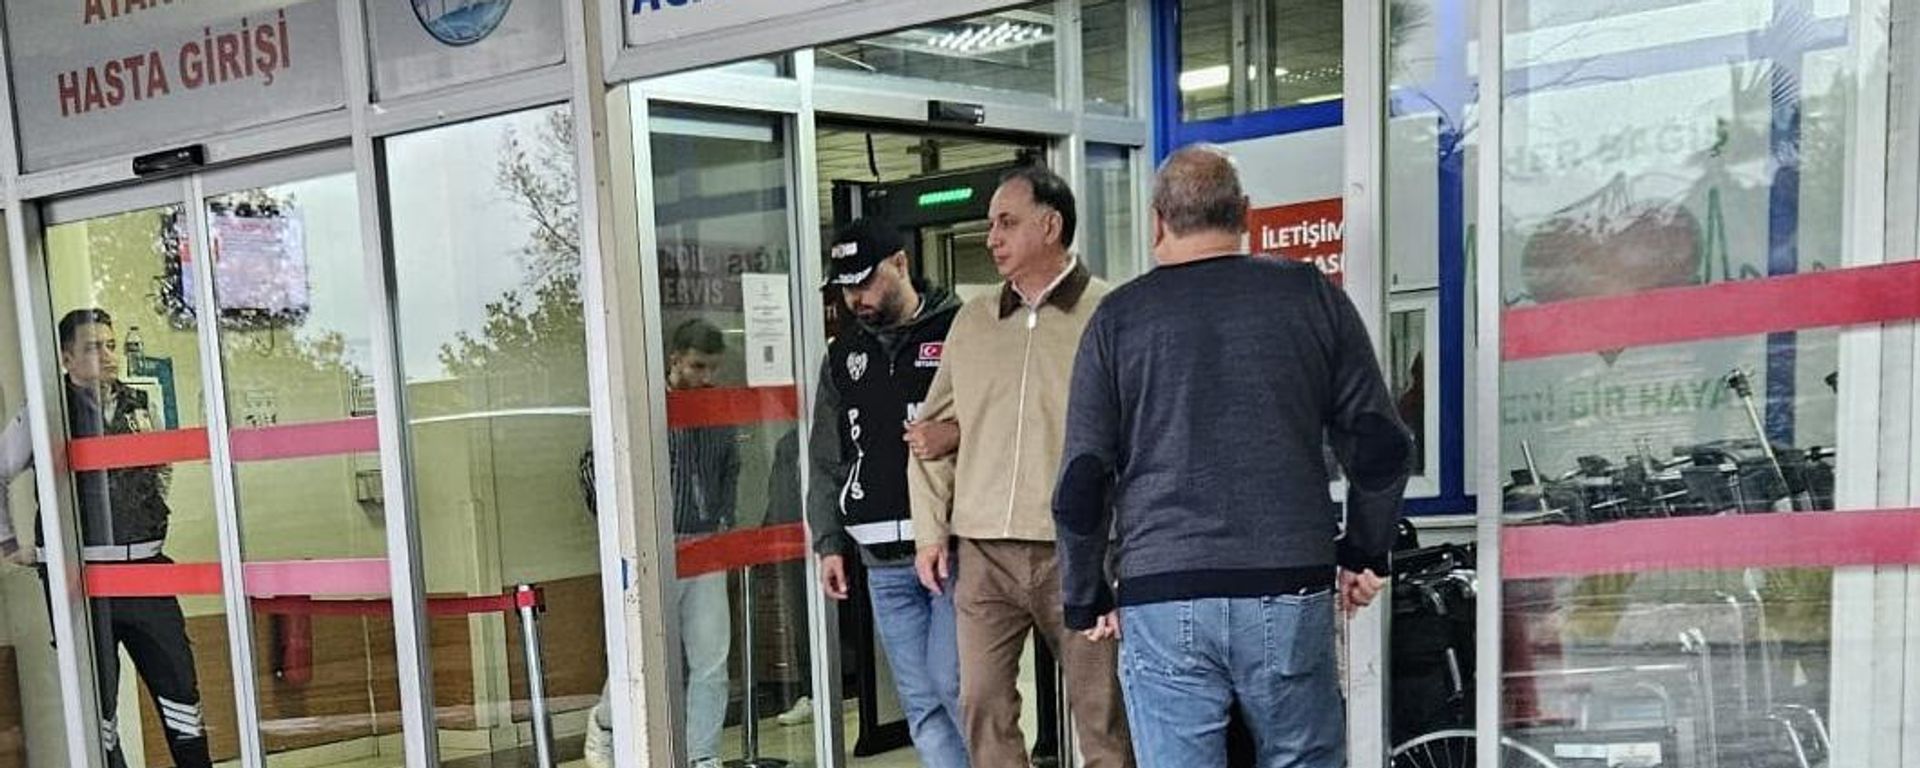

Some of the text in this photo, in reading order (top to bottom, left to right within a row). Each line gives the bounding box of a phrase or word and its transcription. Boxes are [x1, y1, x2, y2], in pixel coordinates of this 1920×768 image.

[57, 8, 291, 117] HASTA GİRİŞİ
[1504, 386, 1554, 424] ENİ
[1640, 377, 1732, 413] HAYA
